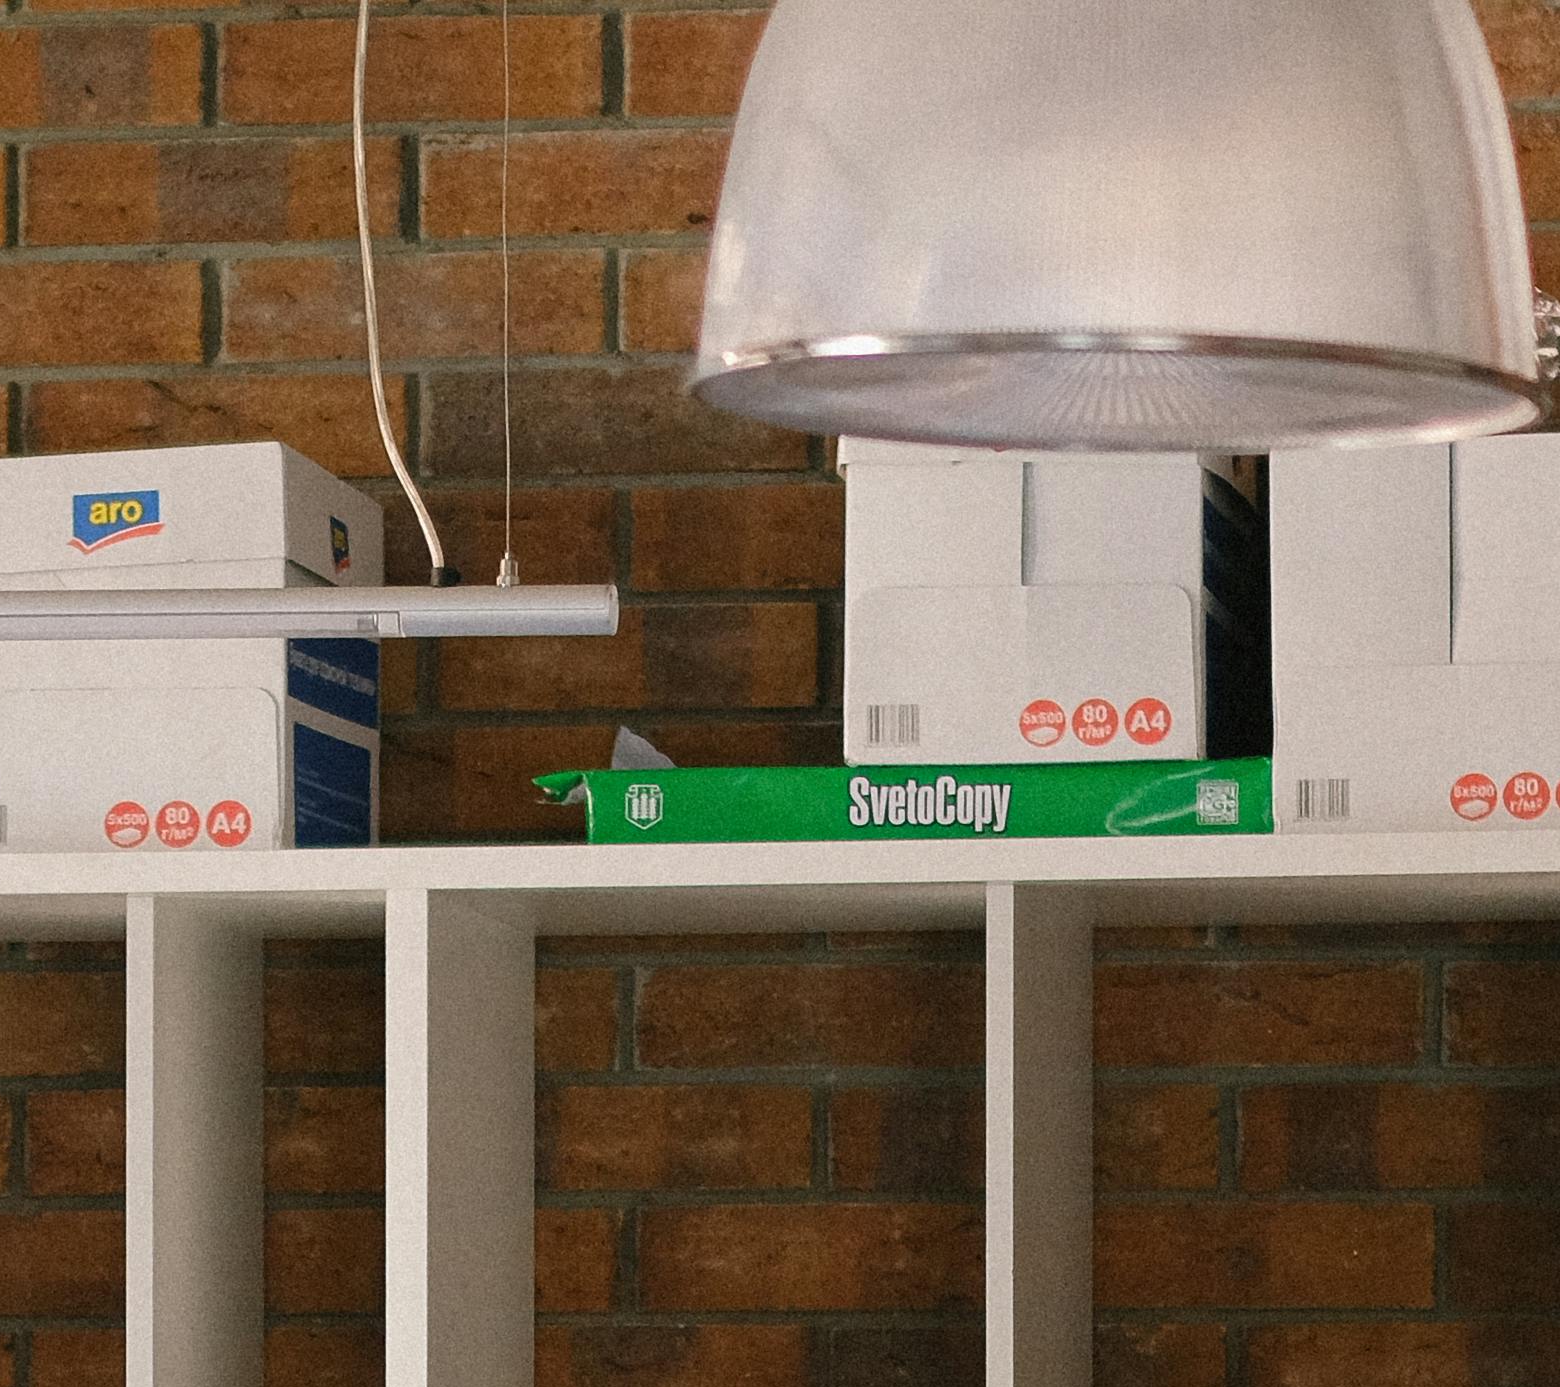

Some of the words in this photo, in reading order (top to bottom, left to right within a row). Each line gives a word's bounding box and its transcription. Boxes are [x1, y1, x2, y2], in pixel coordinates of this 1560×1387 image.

[89, 497, 143, 526] aro
[1023, 711, 1063, 724] 5x500
[1082, 704, 1108, 723] 80
[1131, 709, 1167, 733] A4
[1513, 778, 1539, 796] 80
[848, 775, 1012, 832] SvetoCopy
[165, 807, 190, 825] 80
[211, 812, 247, 835] A4
